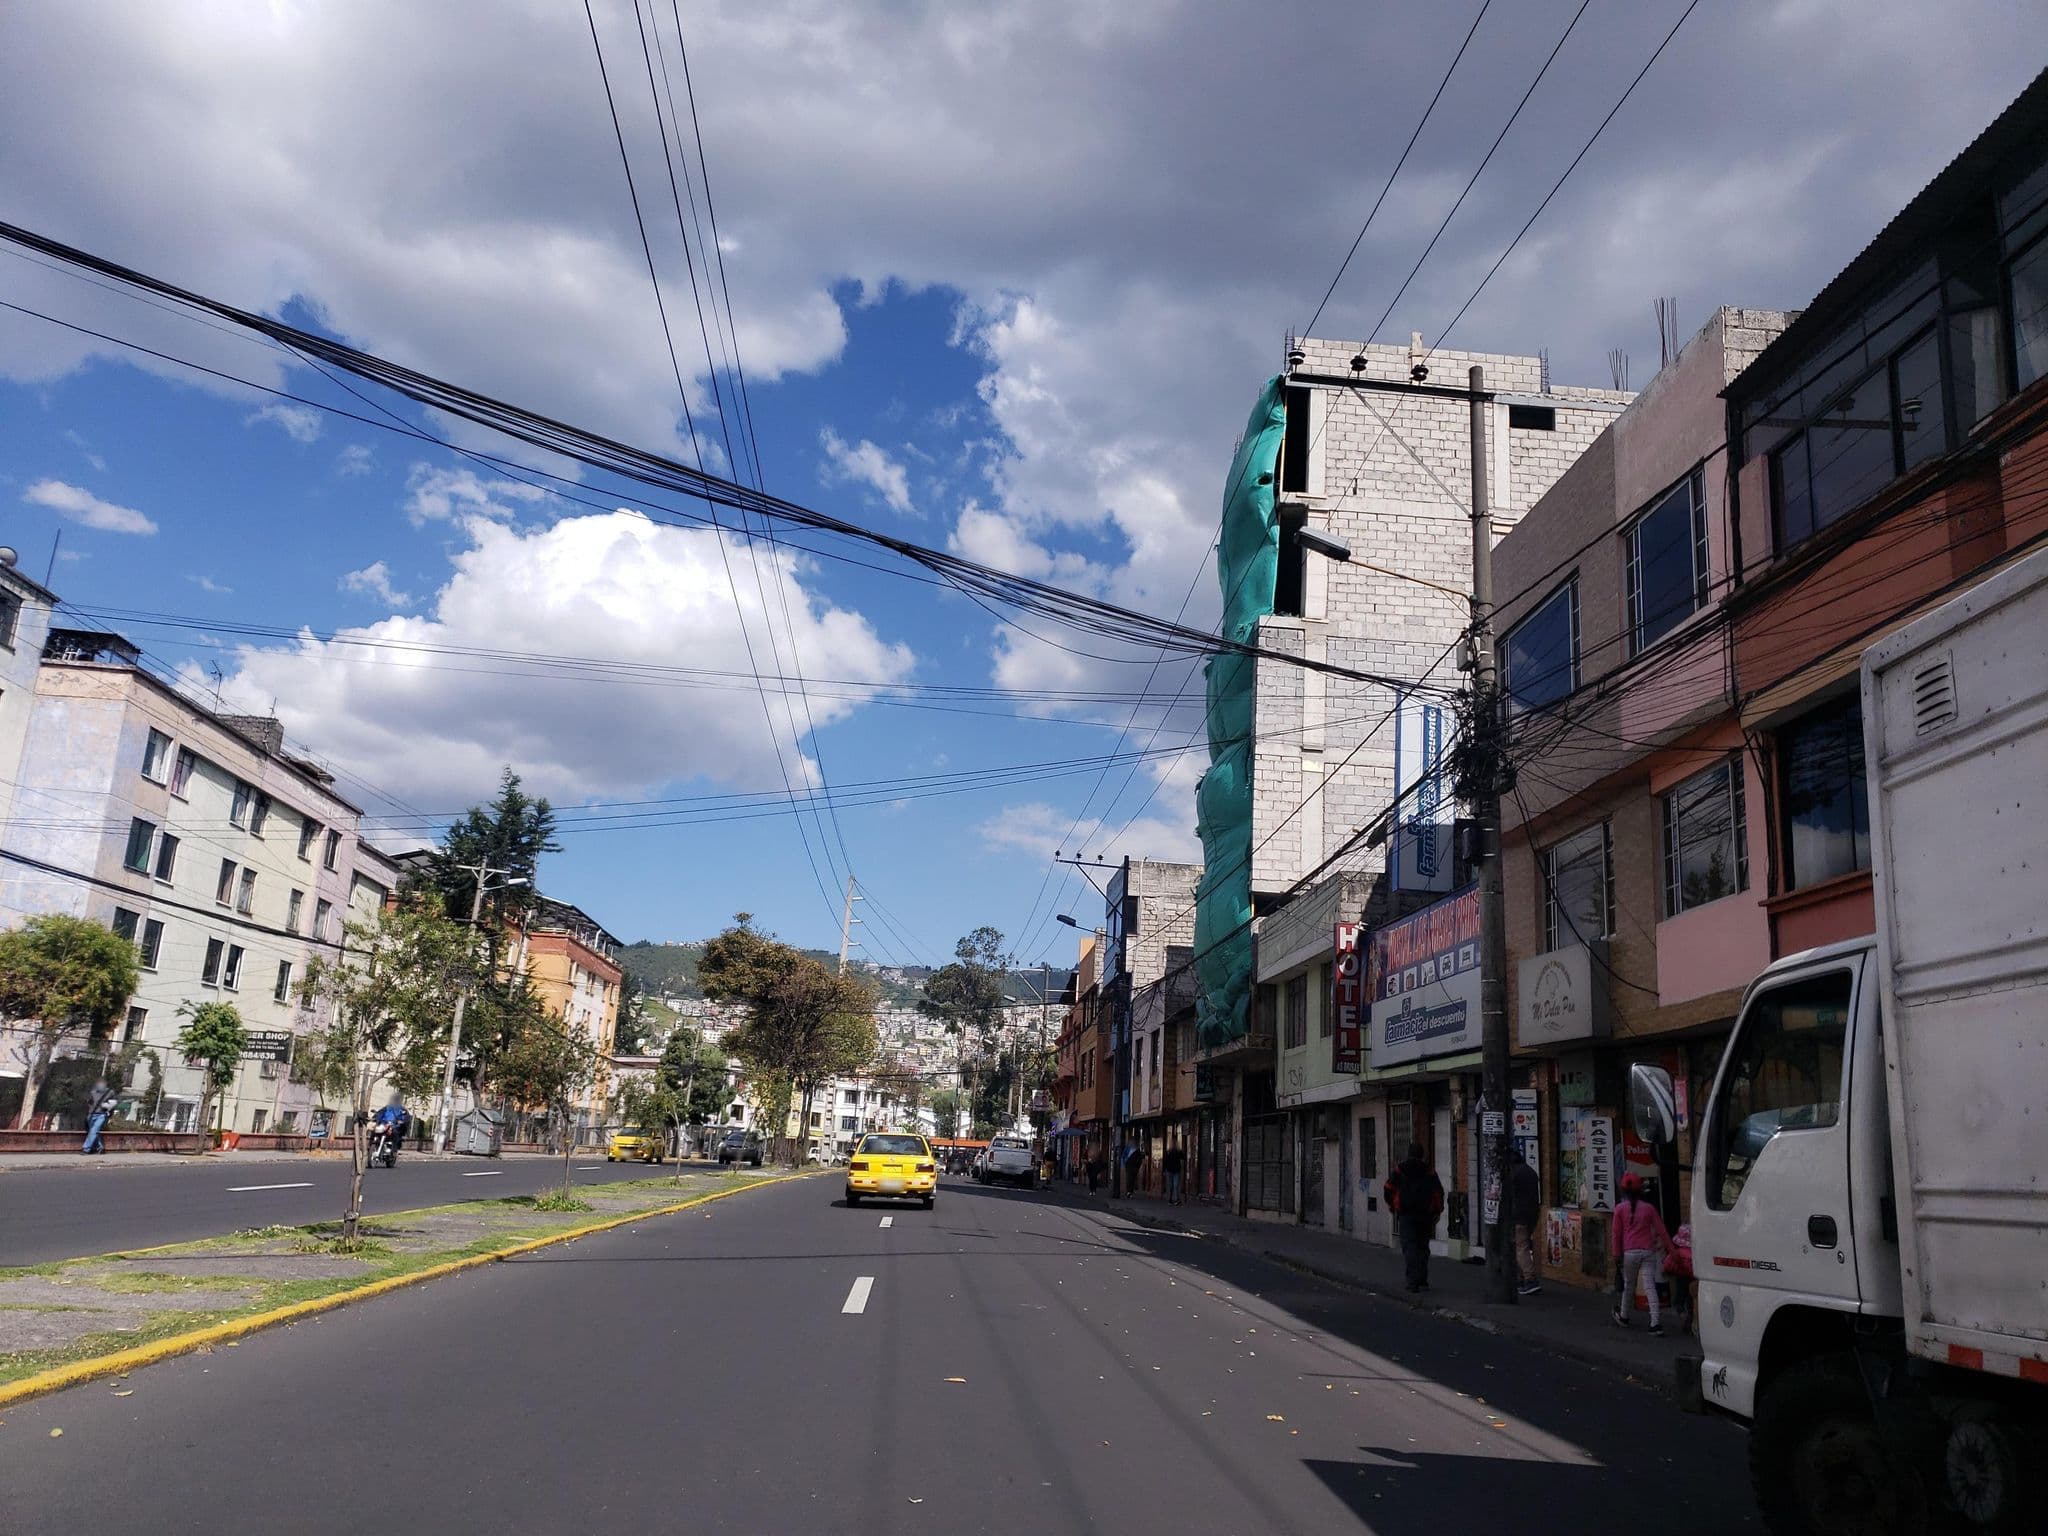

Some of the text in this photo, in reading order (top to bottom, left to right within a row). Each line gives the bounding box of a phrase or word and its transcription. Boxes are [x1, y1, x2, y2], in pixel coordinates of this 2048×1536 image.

[1339, 927, 1359, 1055] HOTEL
[1386, 1011, 1424, 1042] farmacia
[1429, 1010, 1465, 1029] descuento
[1591, 1120, 1609, 1209] PASTELERIA
[1751, 1260, 1781, 1272] DIESEL
